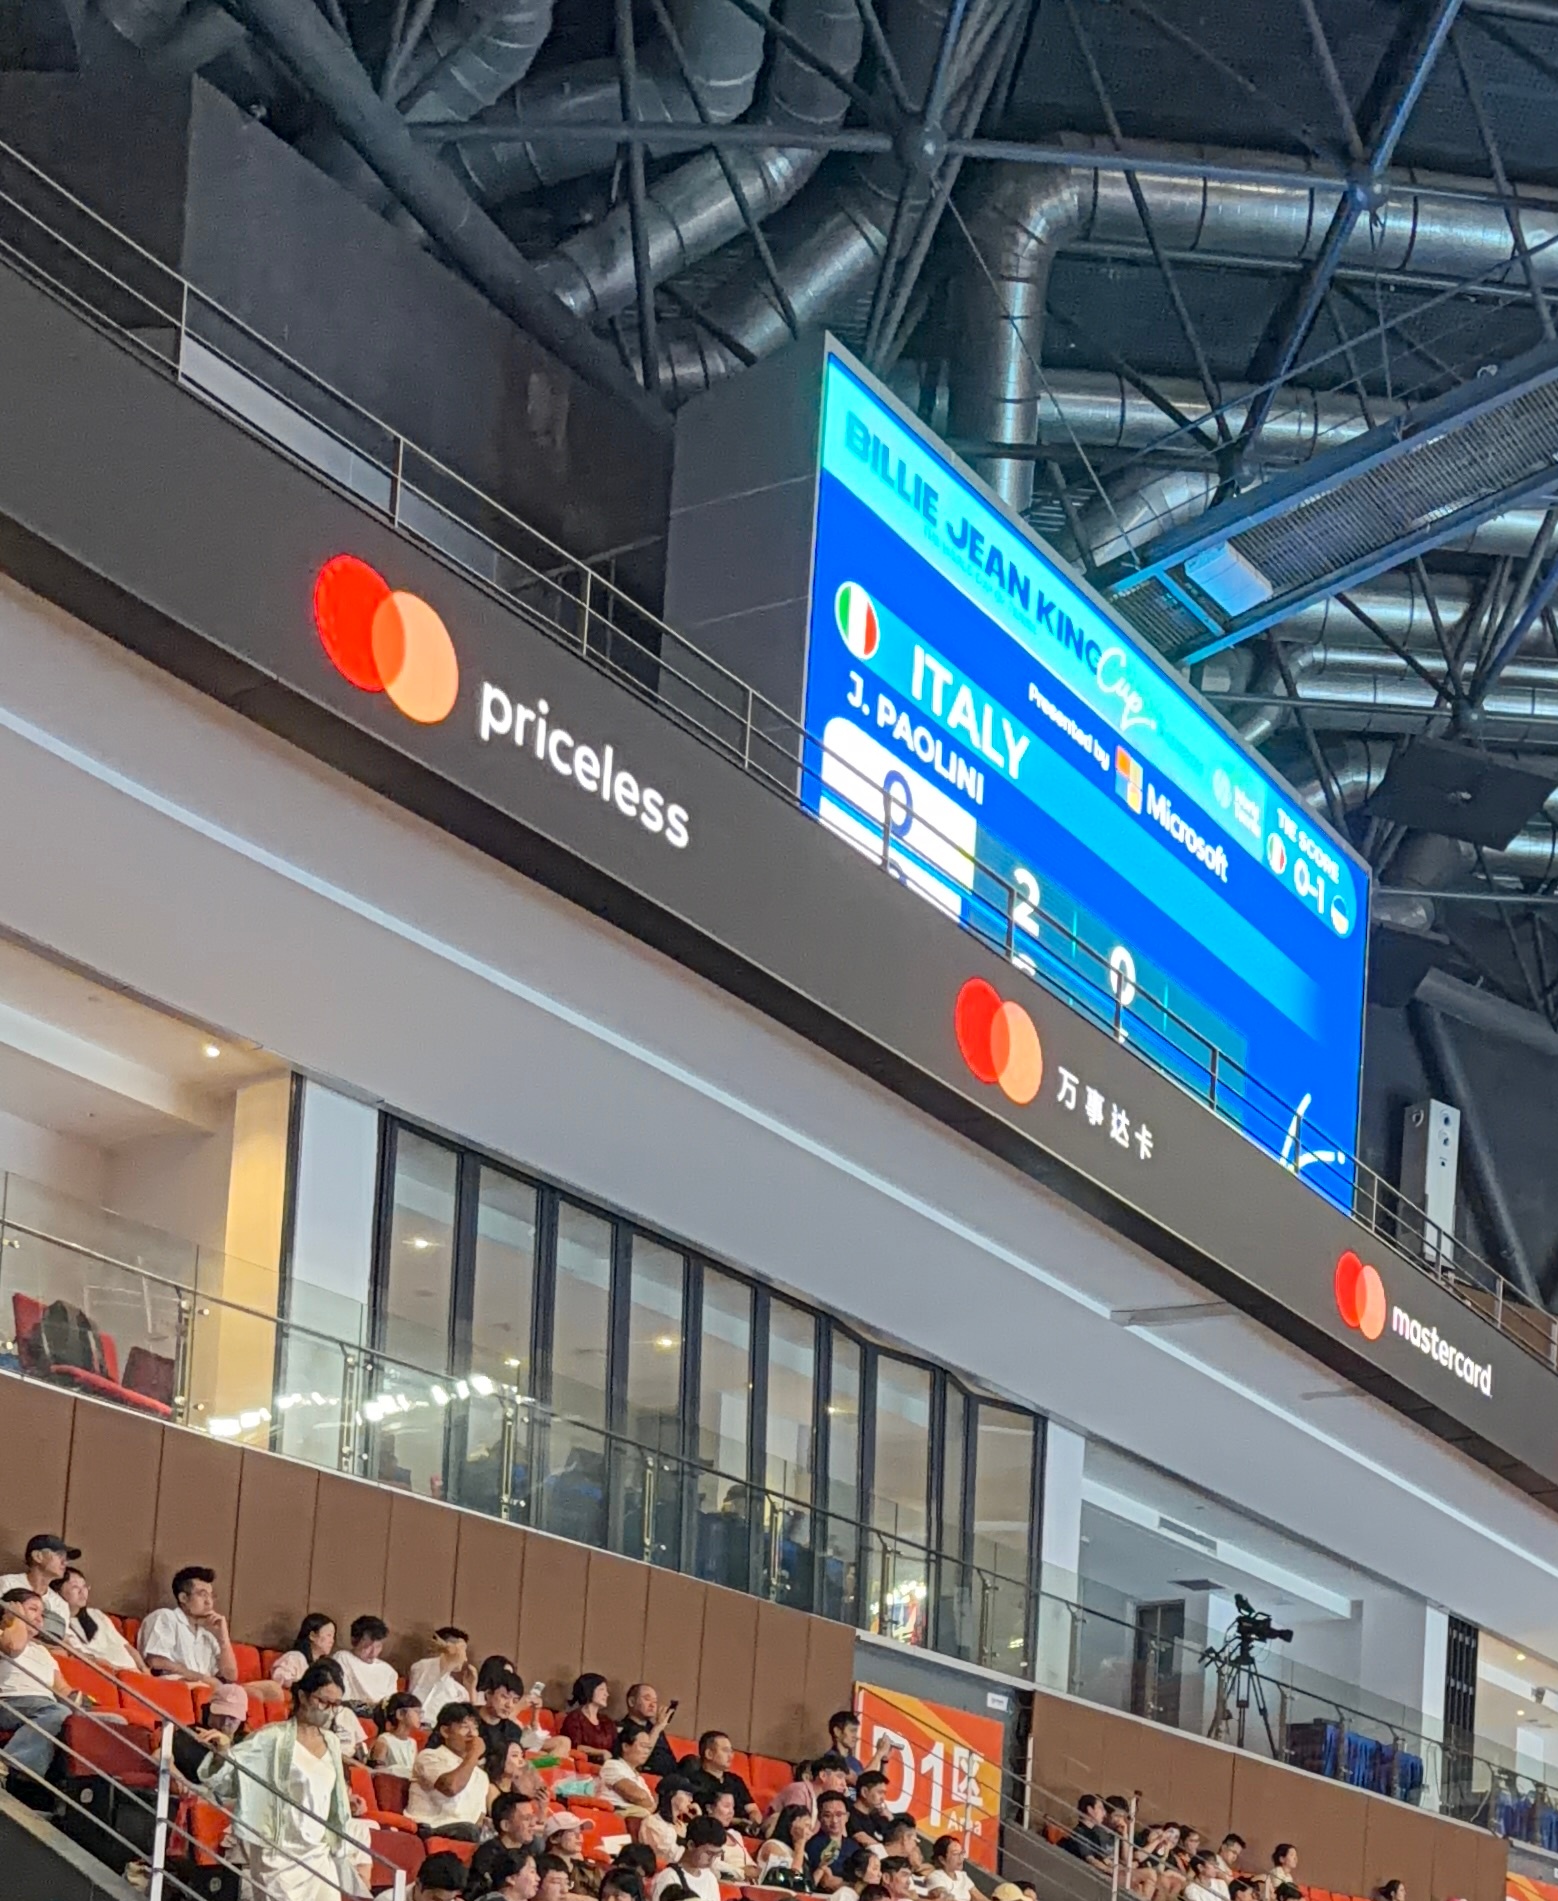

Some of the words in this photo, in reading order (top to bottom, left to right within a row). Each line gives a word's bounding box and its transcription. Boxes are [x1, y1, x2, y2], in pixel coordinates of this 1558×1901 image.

[846, 411, 939, 527] BILLIE
[947, 517, 1031, 612] JEAN
[1037, 591, 1101, 674] KING
[480, 681, 690, 848] priceless
[877, 693, 985, 805] PAOLINI
[912, 645, 1030, 779] ITALY
[1147, 783, 1229, 884] Microsoft
[1056, 1065, 1154, 1160] 万事达卡
[1392, 1301, 1493, 1398] mastercard
[872, 1732, 984, 1828] D1区
